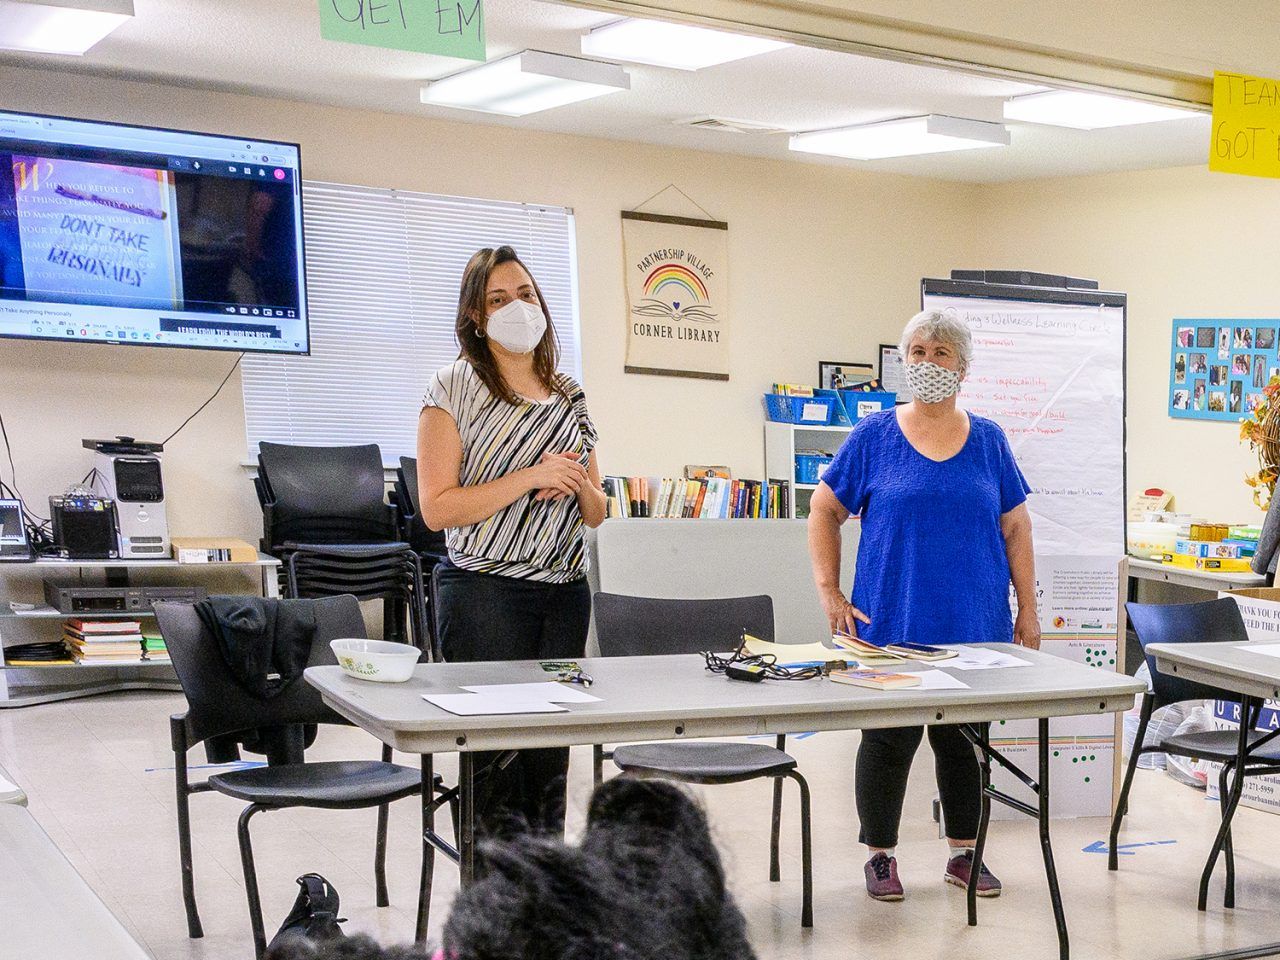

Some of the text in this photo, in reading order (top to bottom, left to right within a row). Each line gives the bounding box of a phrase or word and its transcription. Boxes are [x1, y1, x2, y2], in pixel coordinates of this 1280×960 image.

[1216, 121, 1266, 160] GOT
[108, 226, 150, 253] TAKE
[637, 248, 714, 280] PARTNERSHIP VILLAGE
[19, 308, 43, 317] Anything
[44, 310, 73, 318] Personally
[633, 323, 720, 343] CORNER LIBRARY
[991, 314, 1033, 328] Wellness
[1036, 315, 1077, 335] Learning
[1239, 604, 1257, 616] HANK
[1257, 607, 1272, 618] YOU
[1261, 621, 1275, 632] THE
[1248, 782, 1275, 795] 271-5959
